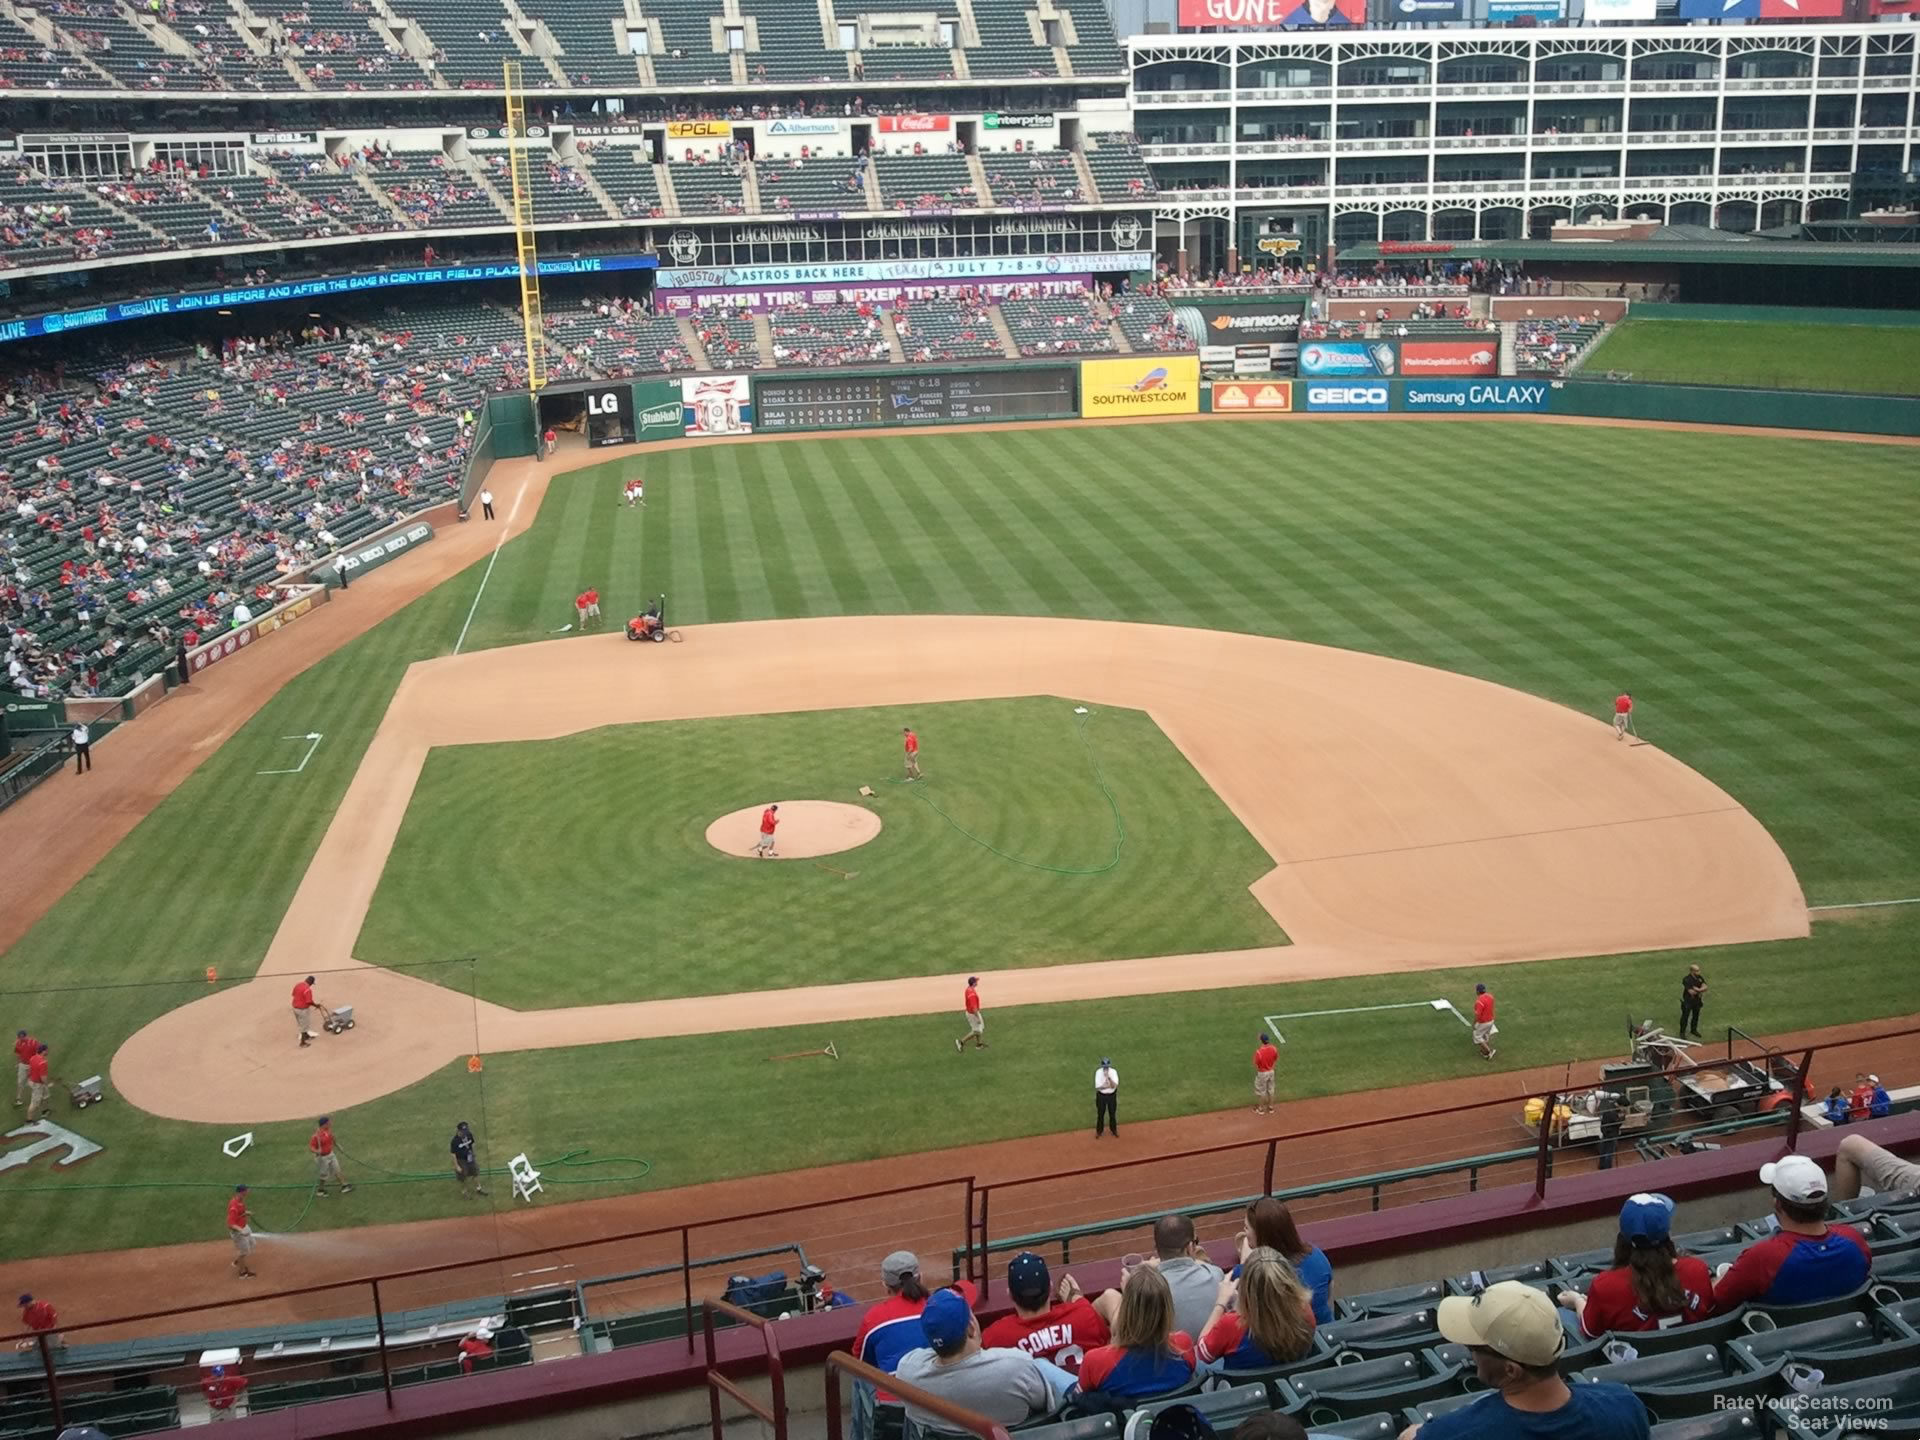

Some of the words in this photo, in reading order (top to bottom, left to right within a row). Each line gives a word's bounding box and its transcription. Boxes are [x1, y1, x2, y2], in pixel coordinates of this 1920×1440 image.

[901, 117, 936, 130] Coca-Cola
[988, 114, 1053, 126] enterprise
[680, 123, 718, 135] PGL
[788, 124, 835, 133] Albertsons
[867, 222, 899, 238] JACK
[995, 216, 1026, 233] JACK
[736, 226, 769, 243] JACK
[675, 271, 723, 287] HOUSTON
[742, 269, 790, 281] ASTROS
[796, 268, 827, 279] BACK
[833, 266, 864, 277] HERE
[886, 263, 926, 278] TEXAS
[948, 262, 986, 273] JULY
[64, 308, 107, 328] SOUTHWEST
[145, 298, 169, 314] LIVE
[177, 296, 202, 309] JOIN
[205, 293, 220, 306] US
[223, 290, 265, 304] BEFORE
[268, 286, 290, 298] AND
[293, 282, 327, 296] AFTER
[328, 280, 348, 291] THE
[350, 276, 377, 288] GAME
[379, 274, 388, 285] IN
[391, 271, 442, 283] CENTER
[447, 268, 482, 279] FIELD
[572, 259, 601, 272] LIVE
[697, 293, 760, 308] NEXEN
[1327, 354, 1369, 364] TOTAL
[588, 392, 618, 415] LG
[1092, 391, 1187, 405] SOUTHWEST.COM
[1308, 388, 1388, 404] GEICO
[1409, 390, 1465, 405] Samsung
[1470, 386, 1545, 404] GALAXY
[642, 407, 680, 425] StubHub!
